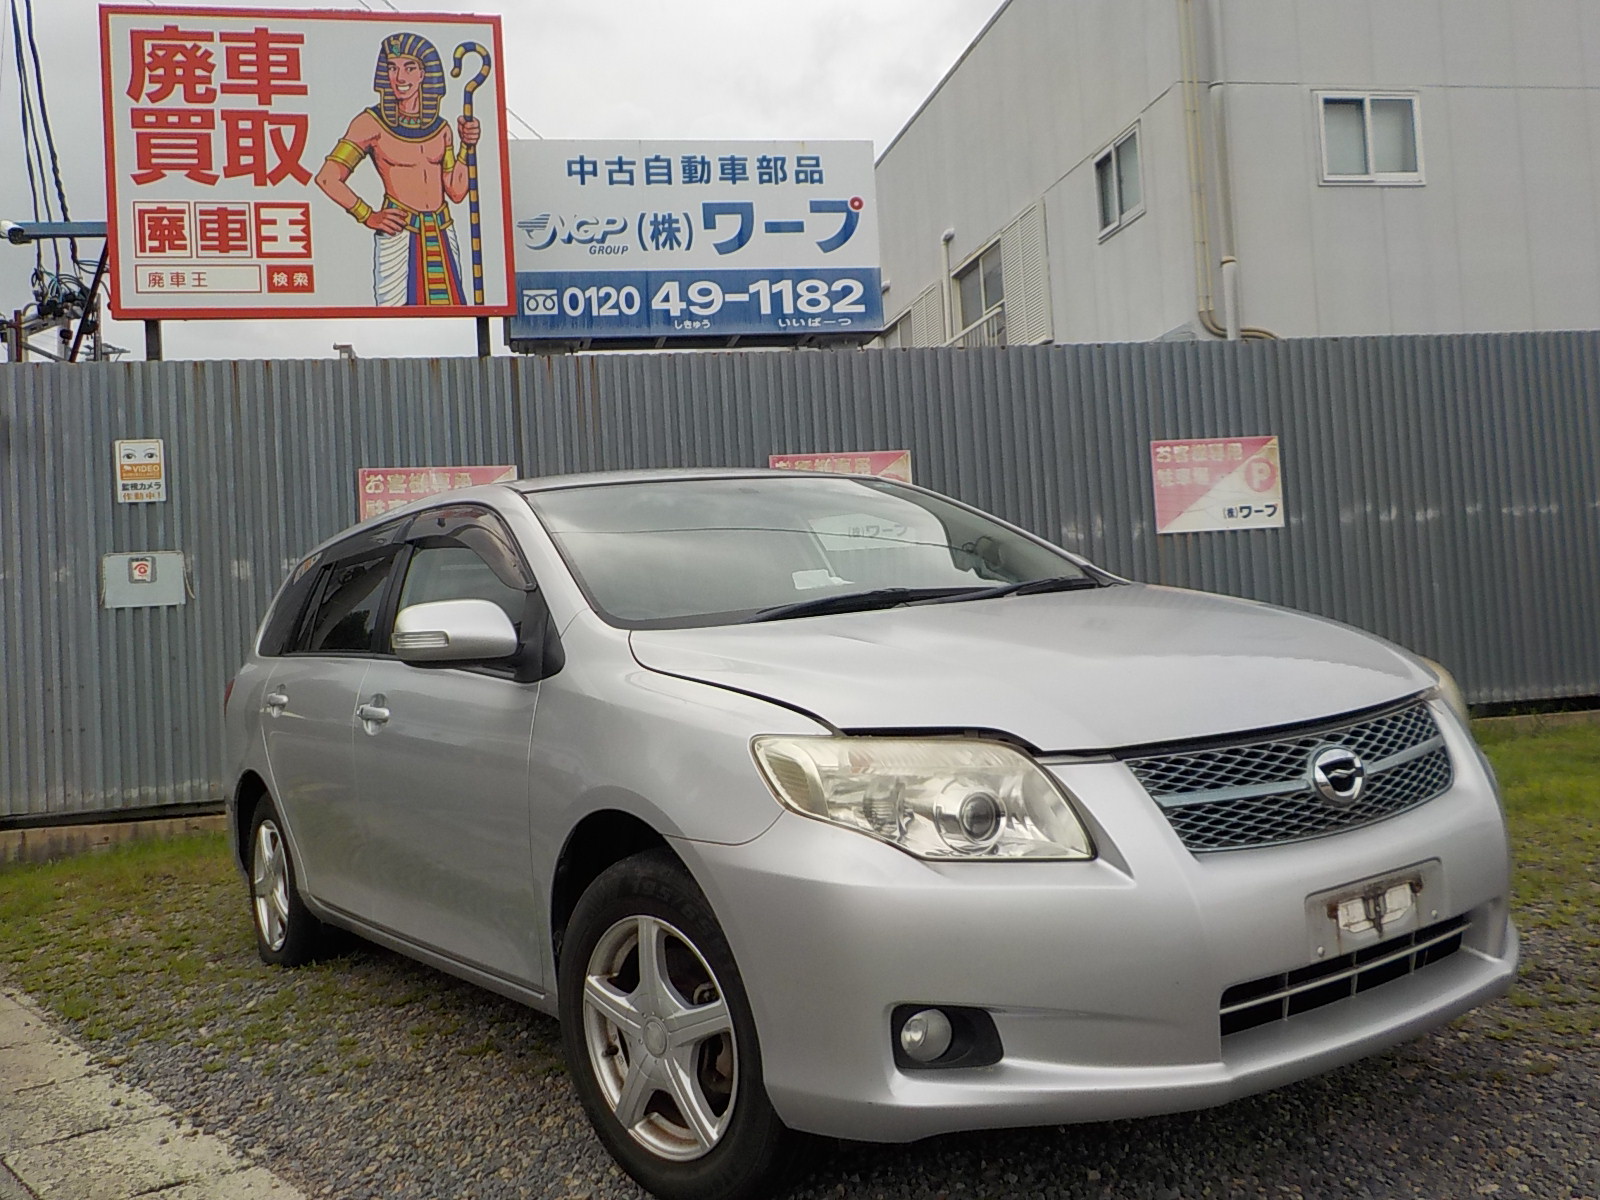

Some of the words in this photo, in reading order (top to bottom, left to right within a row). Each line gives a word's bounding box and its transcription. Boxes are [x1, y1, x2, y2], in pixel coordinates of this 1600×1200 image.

[126, 24, 308, 106] 廃車
[130, 107, 313, 187] 買取
[566, 154, 824, 186] 中古自動車部品
[137, 203, 311, 257] 廃車王
[588, 245, 629, 255] GROUP
[147, 271, 209, 288] 廃車王
[272, 271, 309, 287] 検索
[562, 285, 641, 317] 0120
[651, 279, 866, 317] 49-1182
[674, 319, 711, 330] しきゅう
[132, 464, 160, 473] VIDEO
